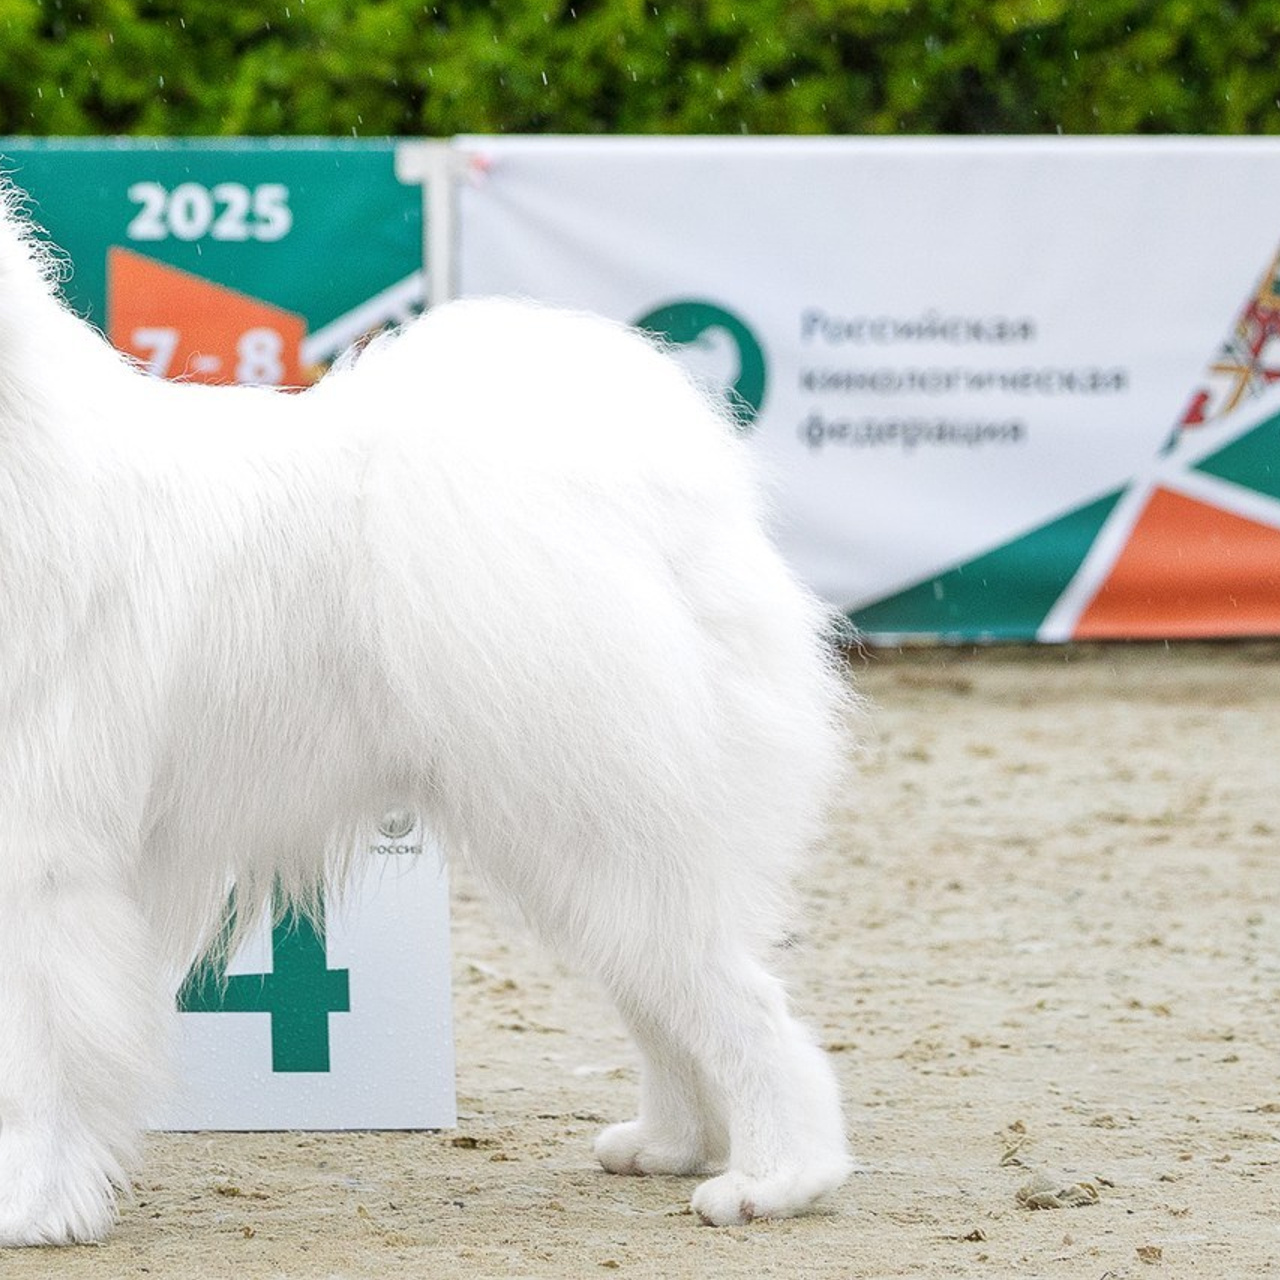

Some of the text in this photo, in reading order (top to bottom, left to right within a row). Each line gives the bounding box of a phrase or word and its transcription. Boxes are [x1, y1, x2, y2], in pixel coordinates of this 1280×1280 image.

[127, 182, 292, 241] 2025
[236, 328, 284, 383] 8
[174, 868, 351, 1073] 4
